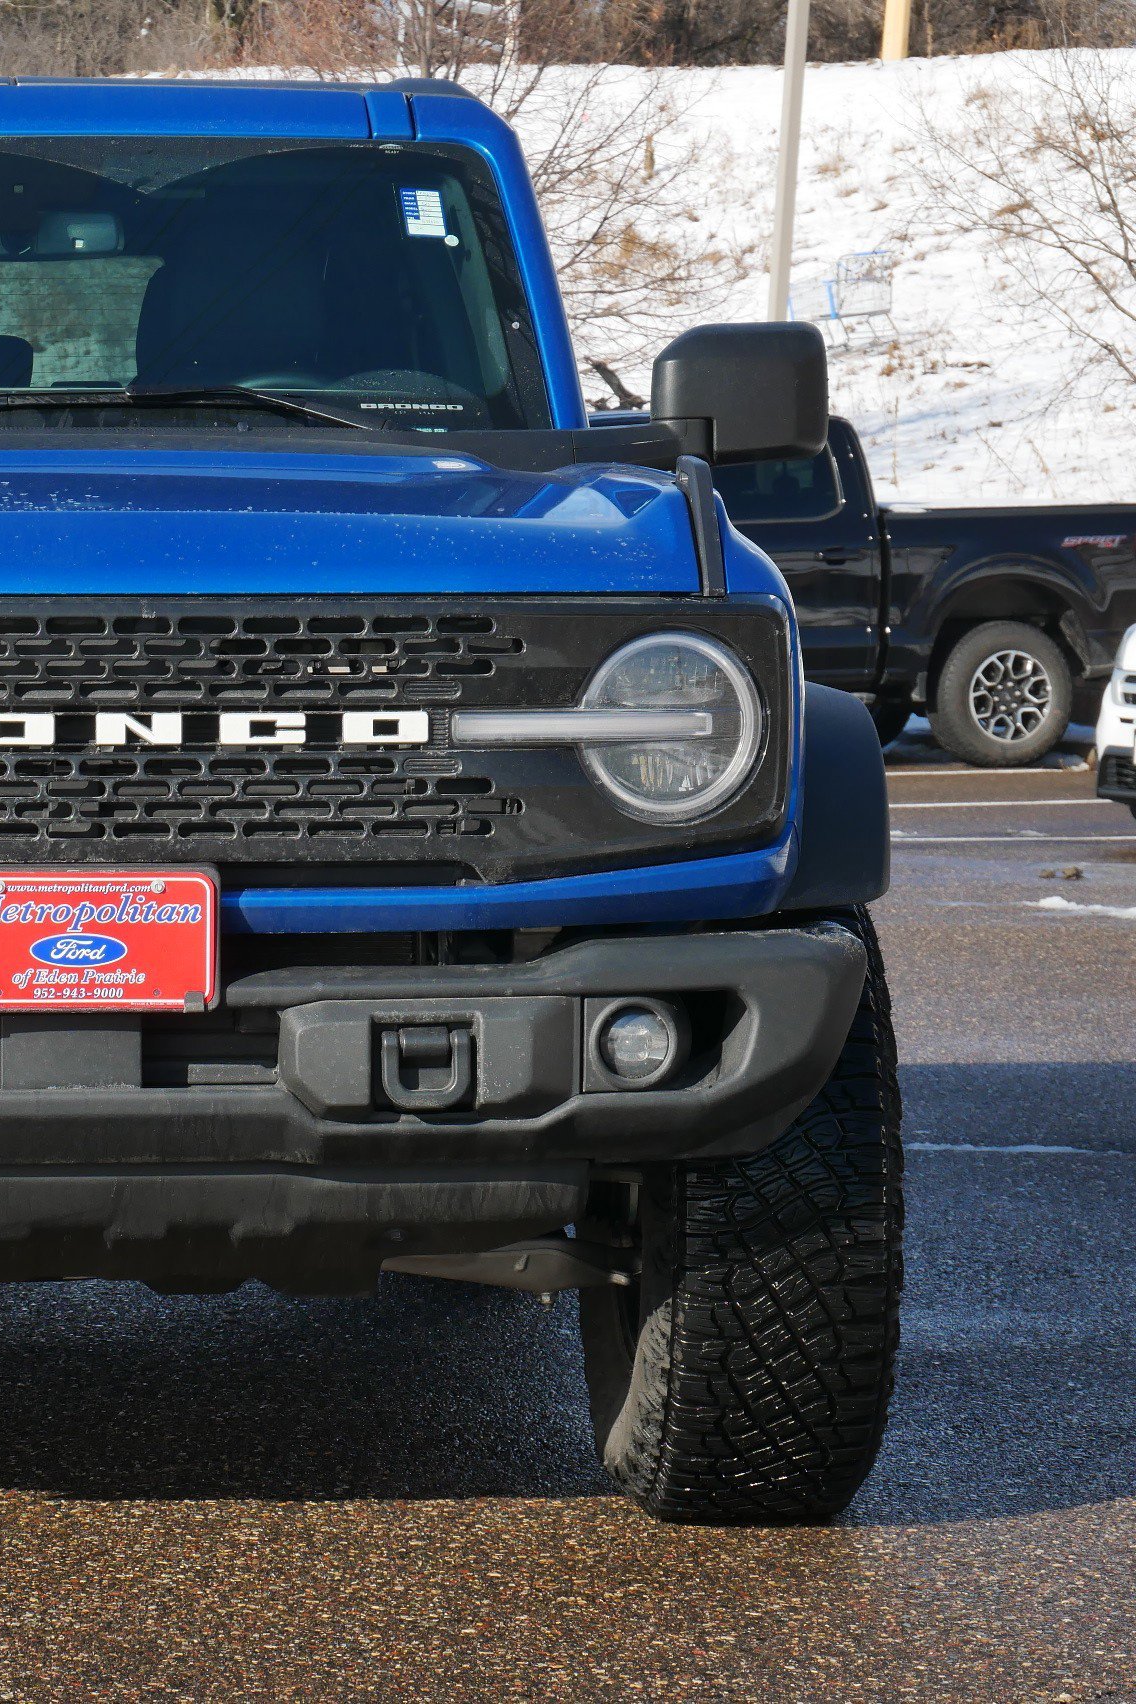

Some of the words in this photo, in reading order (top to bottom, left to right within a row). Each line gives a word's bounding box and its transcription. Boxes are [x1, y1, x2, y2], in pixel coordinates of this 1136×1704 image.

[7, 883, 151, 893] www.metropolitanford.com
[50, 938, 106, 960] Ford
[11, 969, 32, 989] of
[35, 969, 79, 984] Eden
[81, 969, 146, 984] Prairie
[33, 988, 124, 999] 952-943-9000
